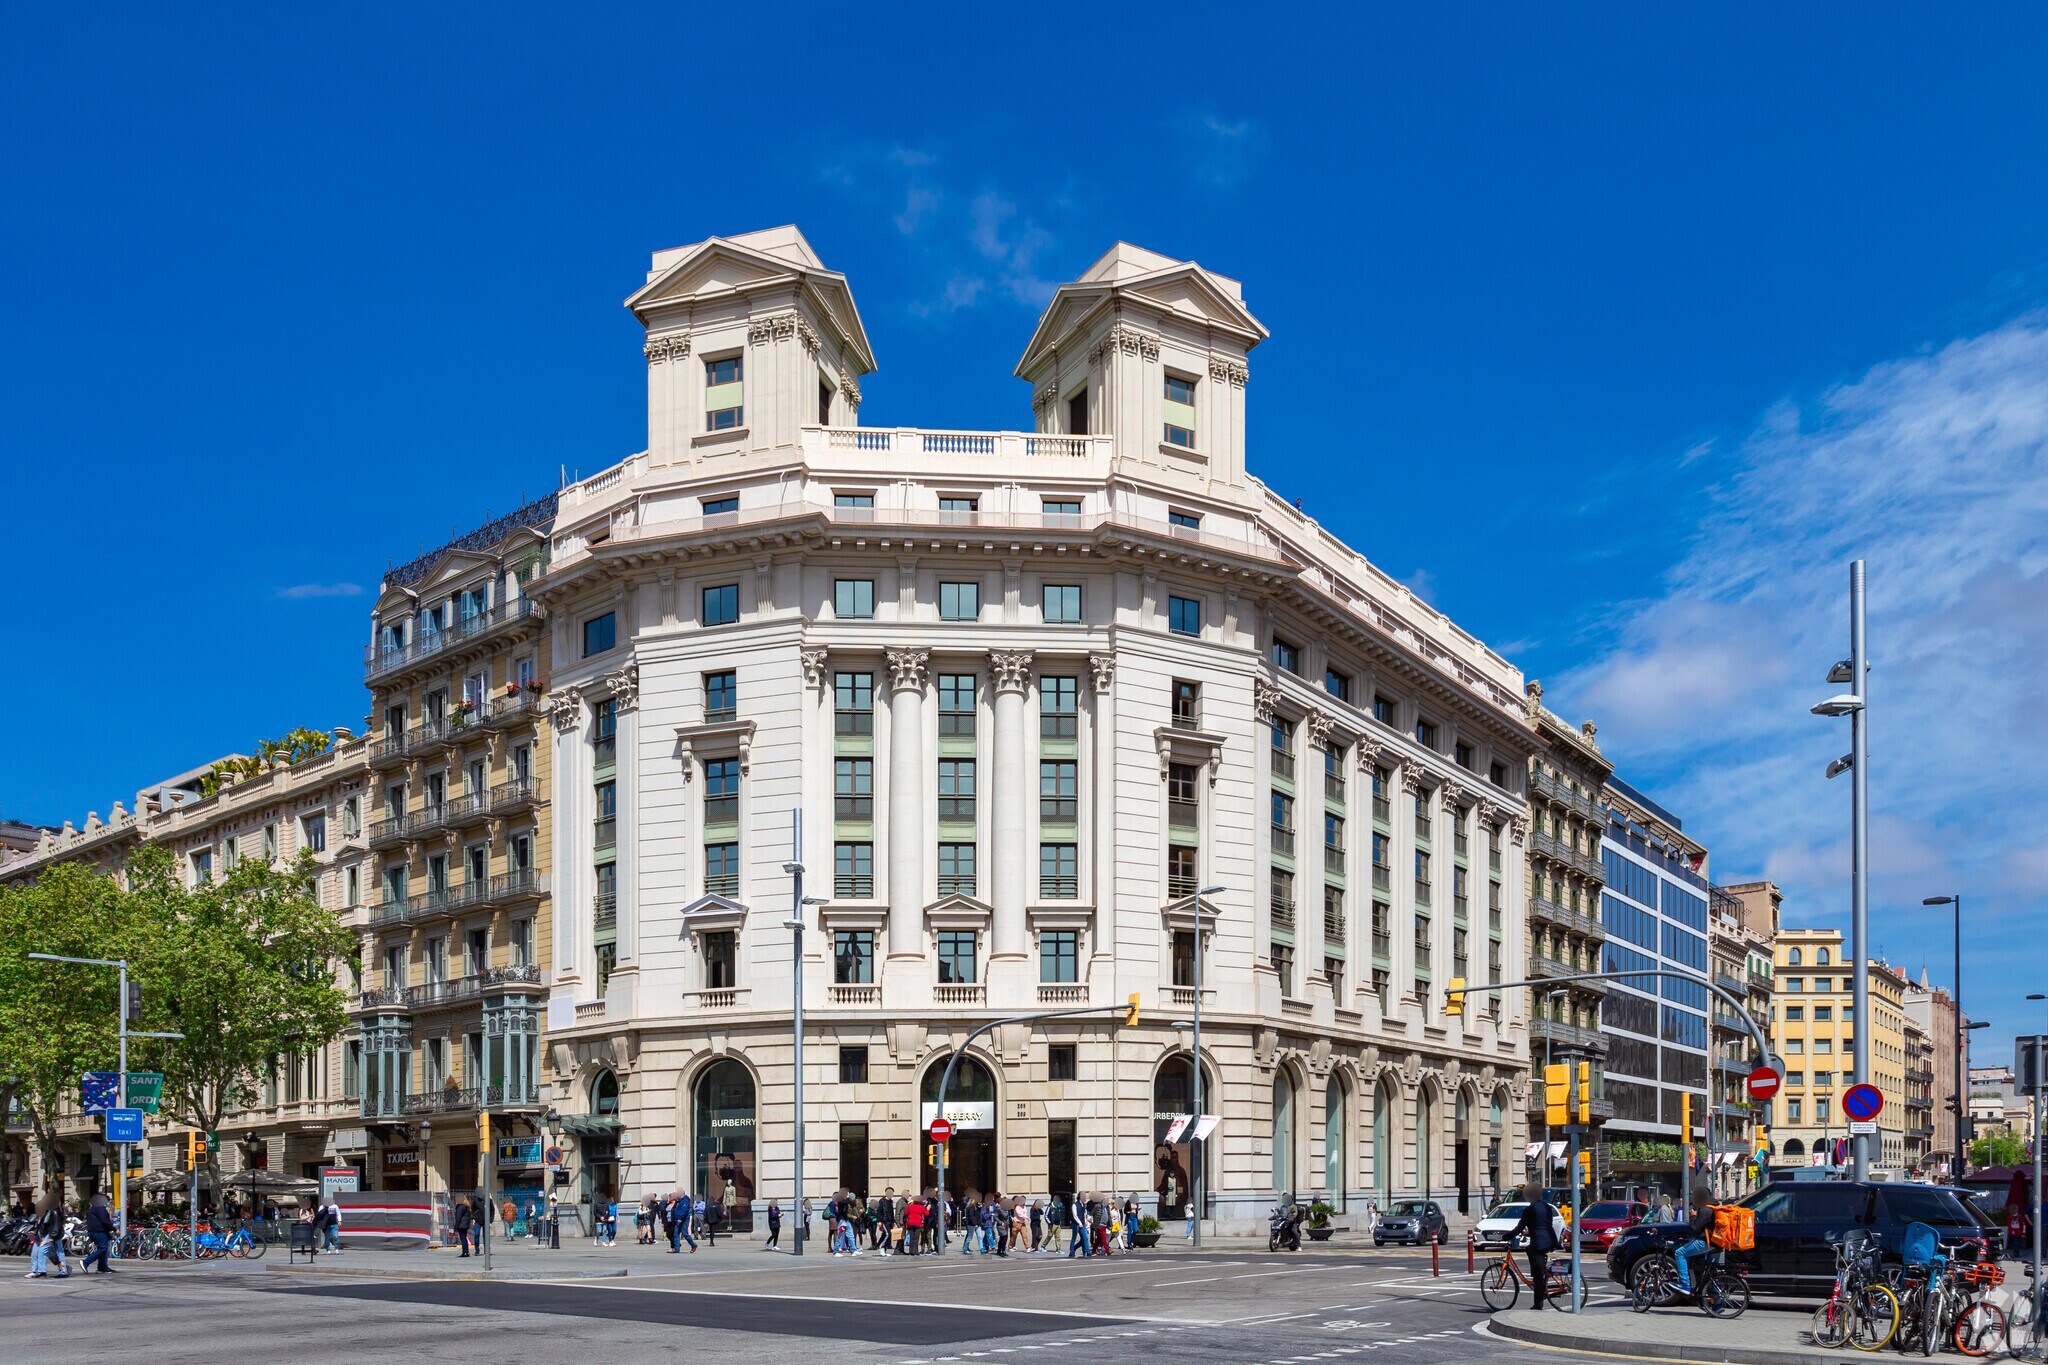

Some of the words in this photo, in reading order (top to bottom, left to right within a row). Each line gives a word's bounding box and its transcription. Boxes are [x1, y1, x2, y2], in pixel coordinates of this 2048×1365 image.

[130, 1077, 159, 1085] SANT
[129, 1096, 157, 1105] JORDI
[933, 1111, 983, 1121] BRBERRY
[711, 1118, 757, 1127] BURBERRY
